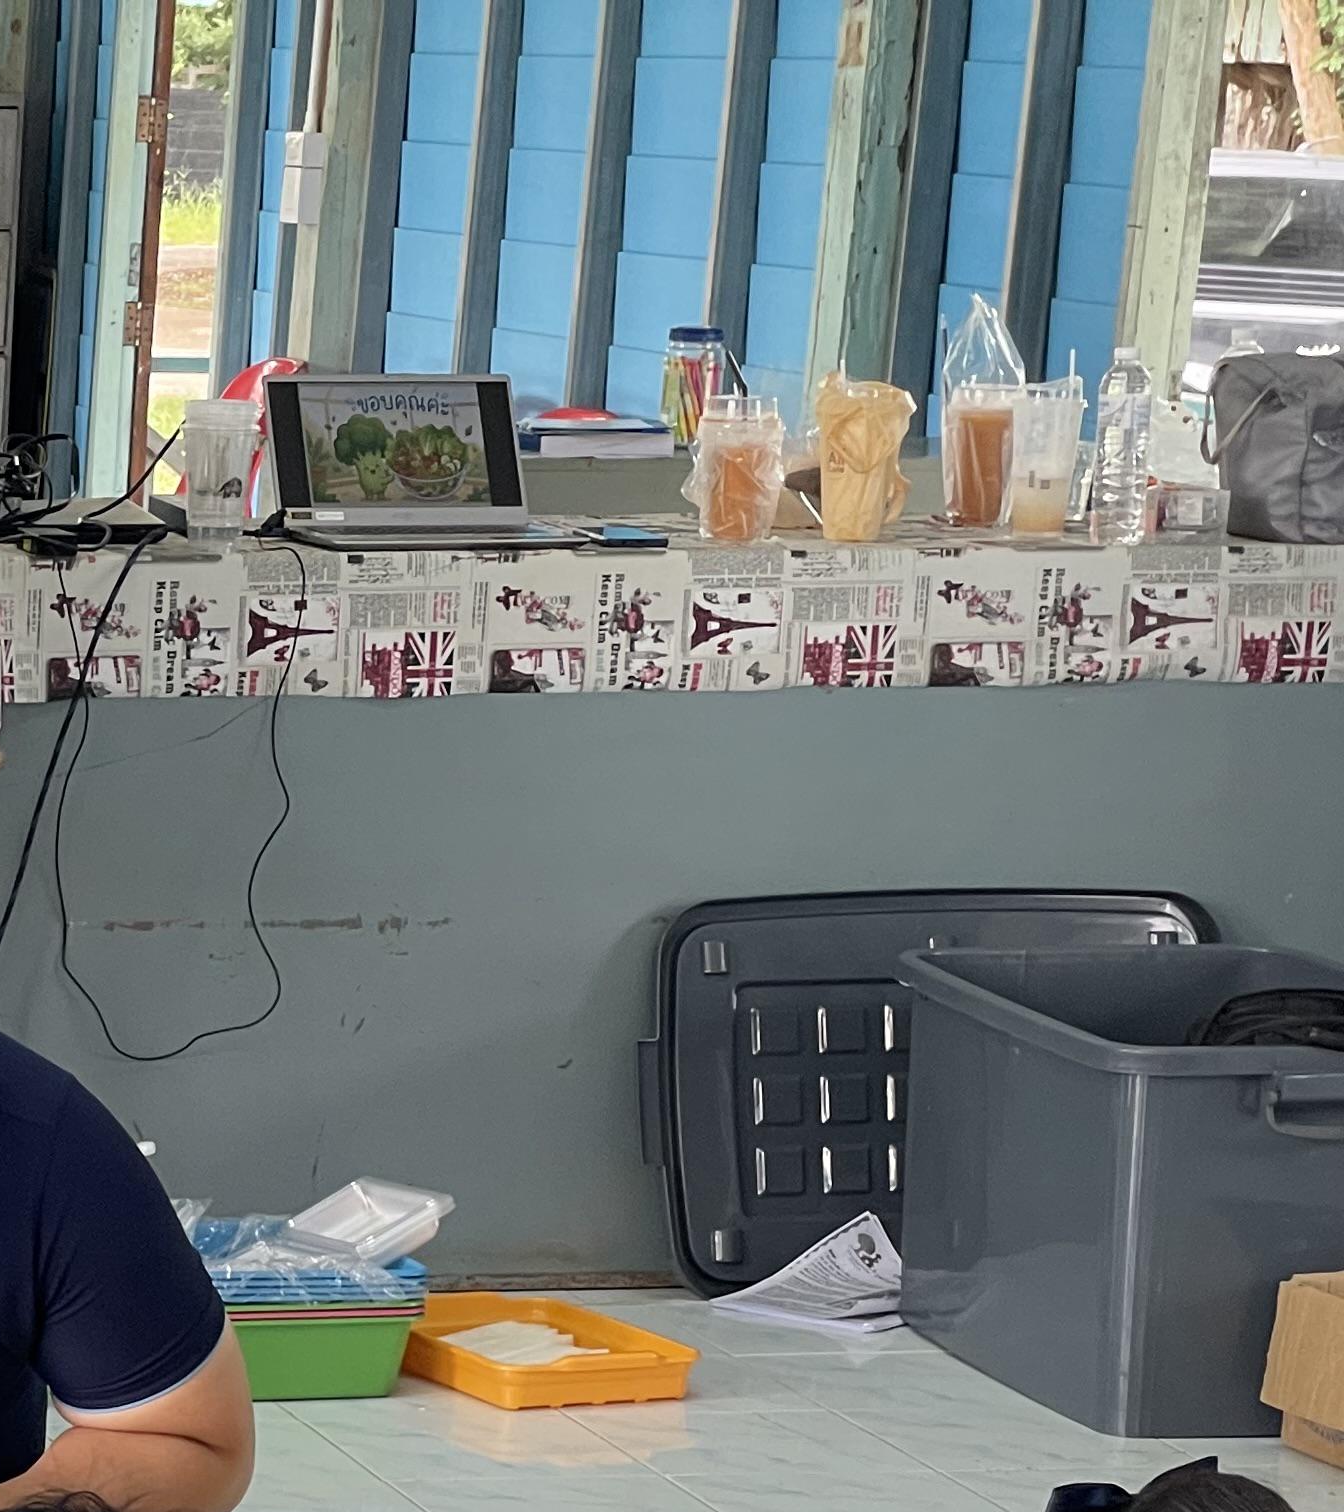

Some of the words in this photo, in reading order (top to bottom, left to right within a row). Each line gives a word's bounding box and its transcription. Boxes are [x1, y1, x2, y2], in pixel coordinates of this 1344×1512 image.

[357, 391, 450, 419] ขอบคุณค่ะ
[154, 580, 167, 614] Keep
[598, 574, 612, 607] Keep
